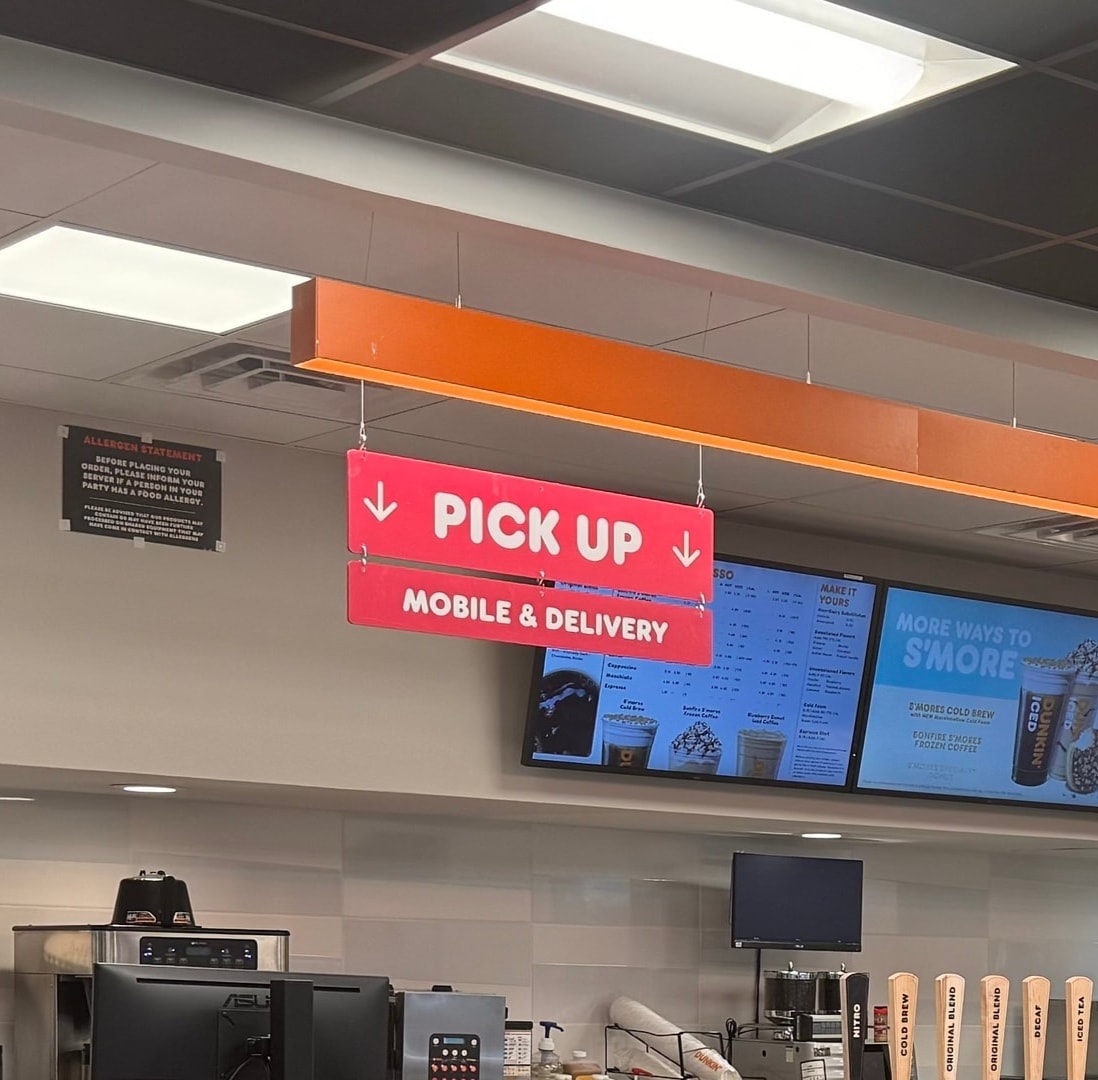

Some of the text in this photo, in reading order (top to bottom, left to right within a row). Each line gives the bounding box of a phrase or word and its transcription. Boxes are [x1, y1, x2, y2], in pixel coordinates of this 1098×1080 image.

[84, 436, 202, 461] ALLERGEN STATEMENT
[96, 456, 191, 477] BEFORE PLACING YOUR
[115, 468, 145, 479] PLEASE
[147, 474, 180, 484] INFORM
[182, 479, 205, 488] YOUR
[82, 482, 109, 491] PARTY
[111, 487, 128, 495] HAS
[138, 490, 162, 500] FOOD
[164, 494, 204, 506] ALLERGY.
[83, 472, 114, 483] SERVER
[134, 480, 167, 491] PERSON
[180, 487, 203, 496] YOUR
[434, 491, 643, 566] PICK UP
[820, 584, 857, 597] MAKE IT
[820, 595, 849, 607] YOURS
[402, 588, 669, 644] MOBILE & DELIVERY
[897, 612, 1031, 647] MORE WAYS TO
[903, 637, 1019, 680] S'MORE
[947, 706, 970, 717] COLD
[972, 709, 995, 719] BREW
[1028, 696, 1042, 732] ICED
[915, 741, 978, 753] FROZEN COFFEE
[222, 994, 270, 1008] ASU
[852, 1003, 861, 1038] NITRO
[900, 993, 909, 1056] COLD BREW
[946, 986, 956, 1072] ORIGINAL BLEND
[990, 987, 1001, 1072] ORIGINAL BLEND
[1034, 1004, 1042, 1038] DECAF
